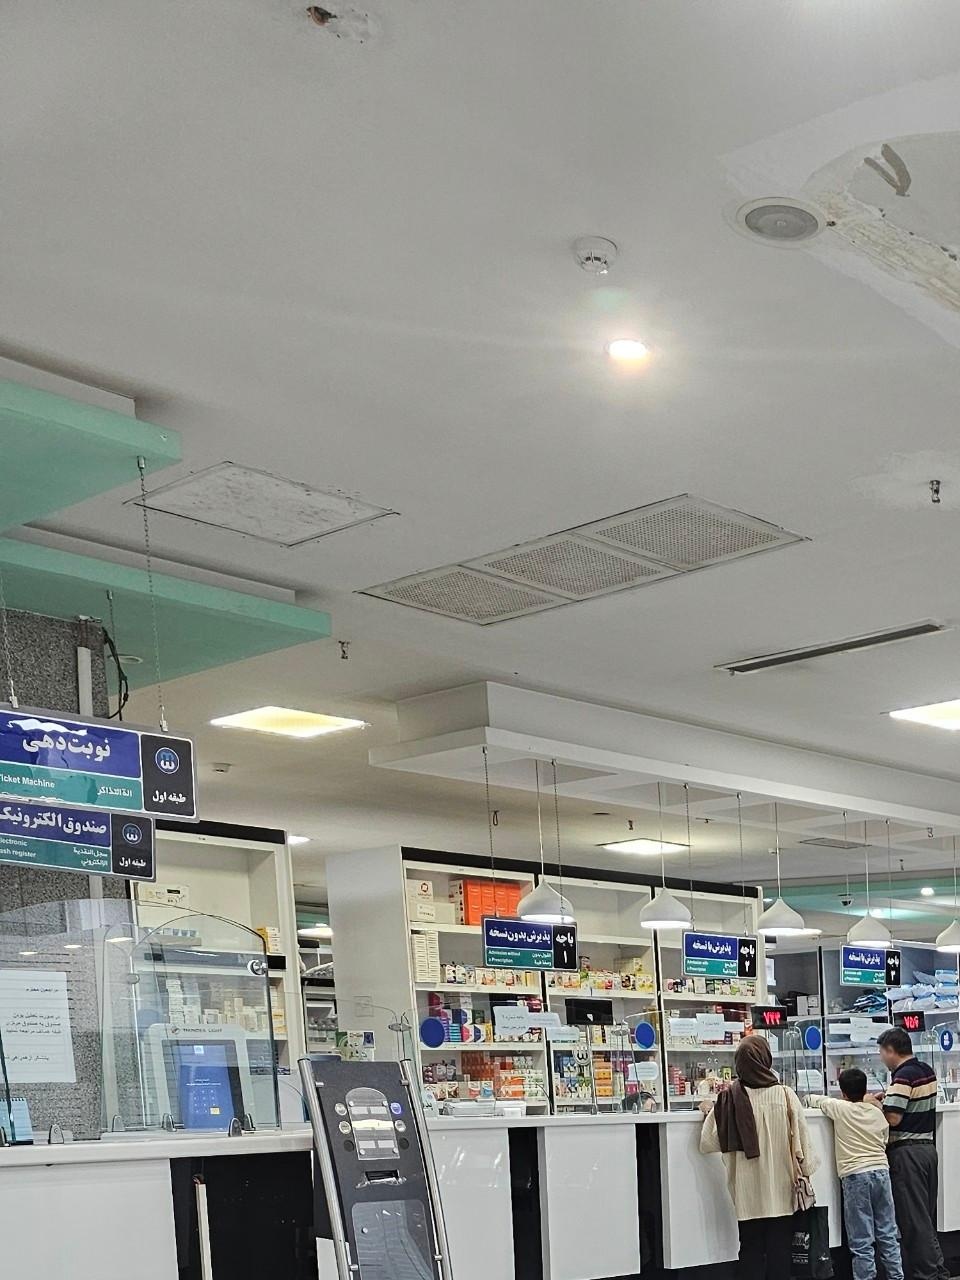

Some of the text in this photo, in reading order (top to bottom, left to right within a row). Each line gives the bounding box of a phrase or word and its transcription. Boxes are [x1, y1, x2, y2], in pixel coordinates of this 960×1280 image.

[22, 776, 56, 788] Machine
[152, 790, 187, 805] طبقه اول
[62, 817, 107, 835] صندوق
[0, 837, 28, 847] lectronic
[12, 849, 37, 858] register
[119, 856, 147, 869] طبقه اول
[489, 925, 508, 938] نسخه
[555, 931, 574, 947] باجه
[740, 944, 755, 958] باجه
[887, 955, 900, 968] باجه
